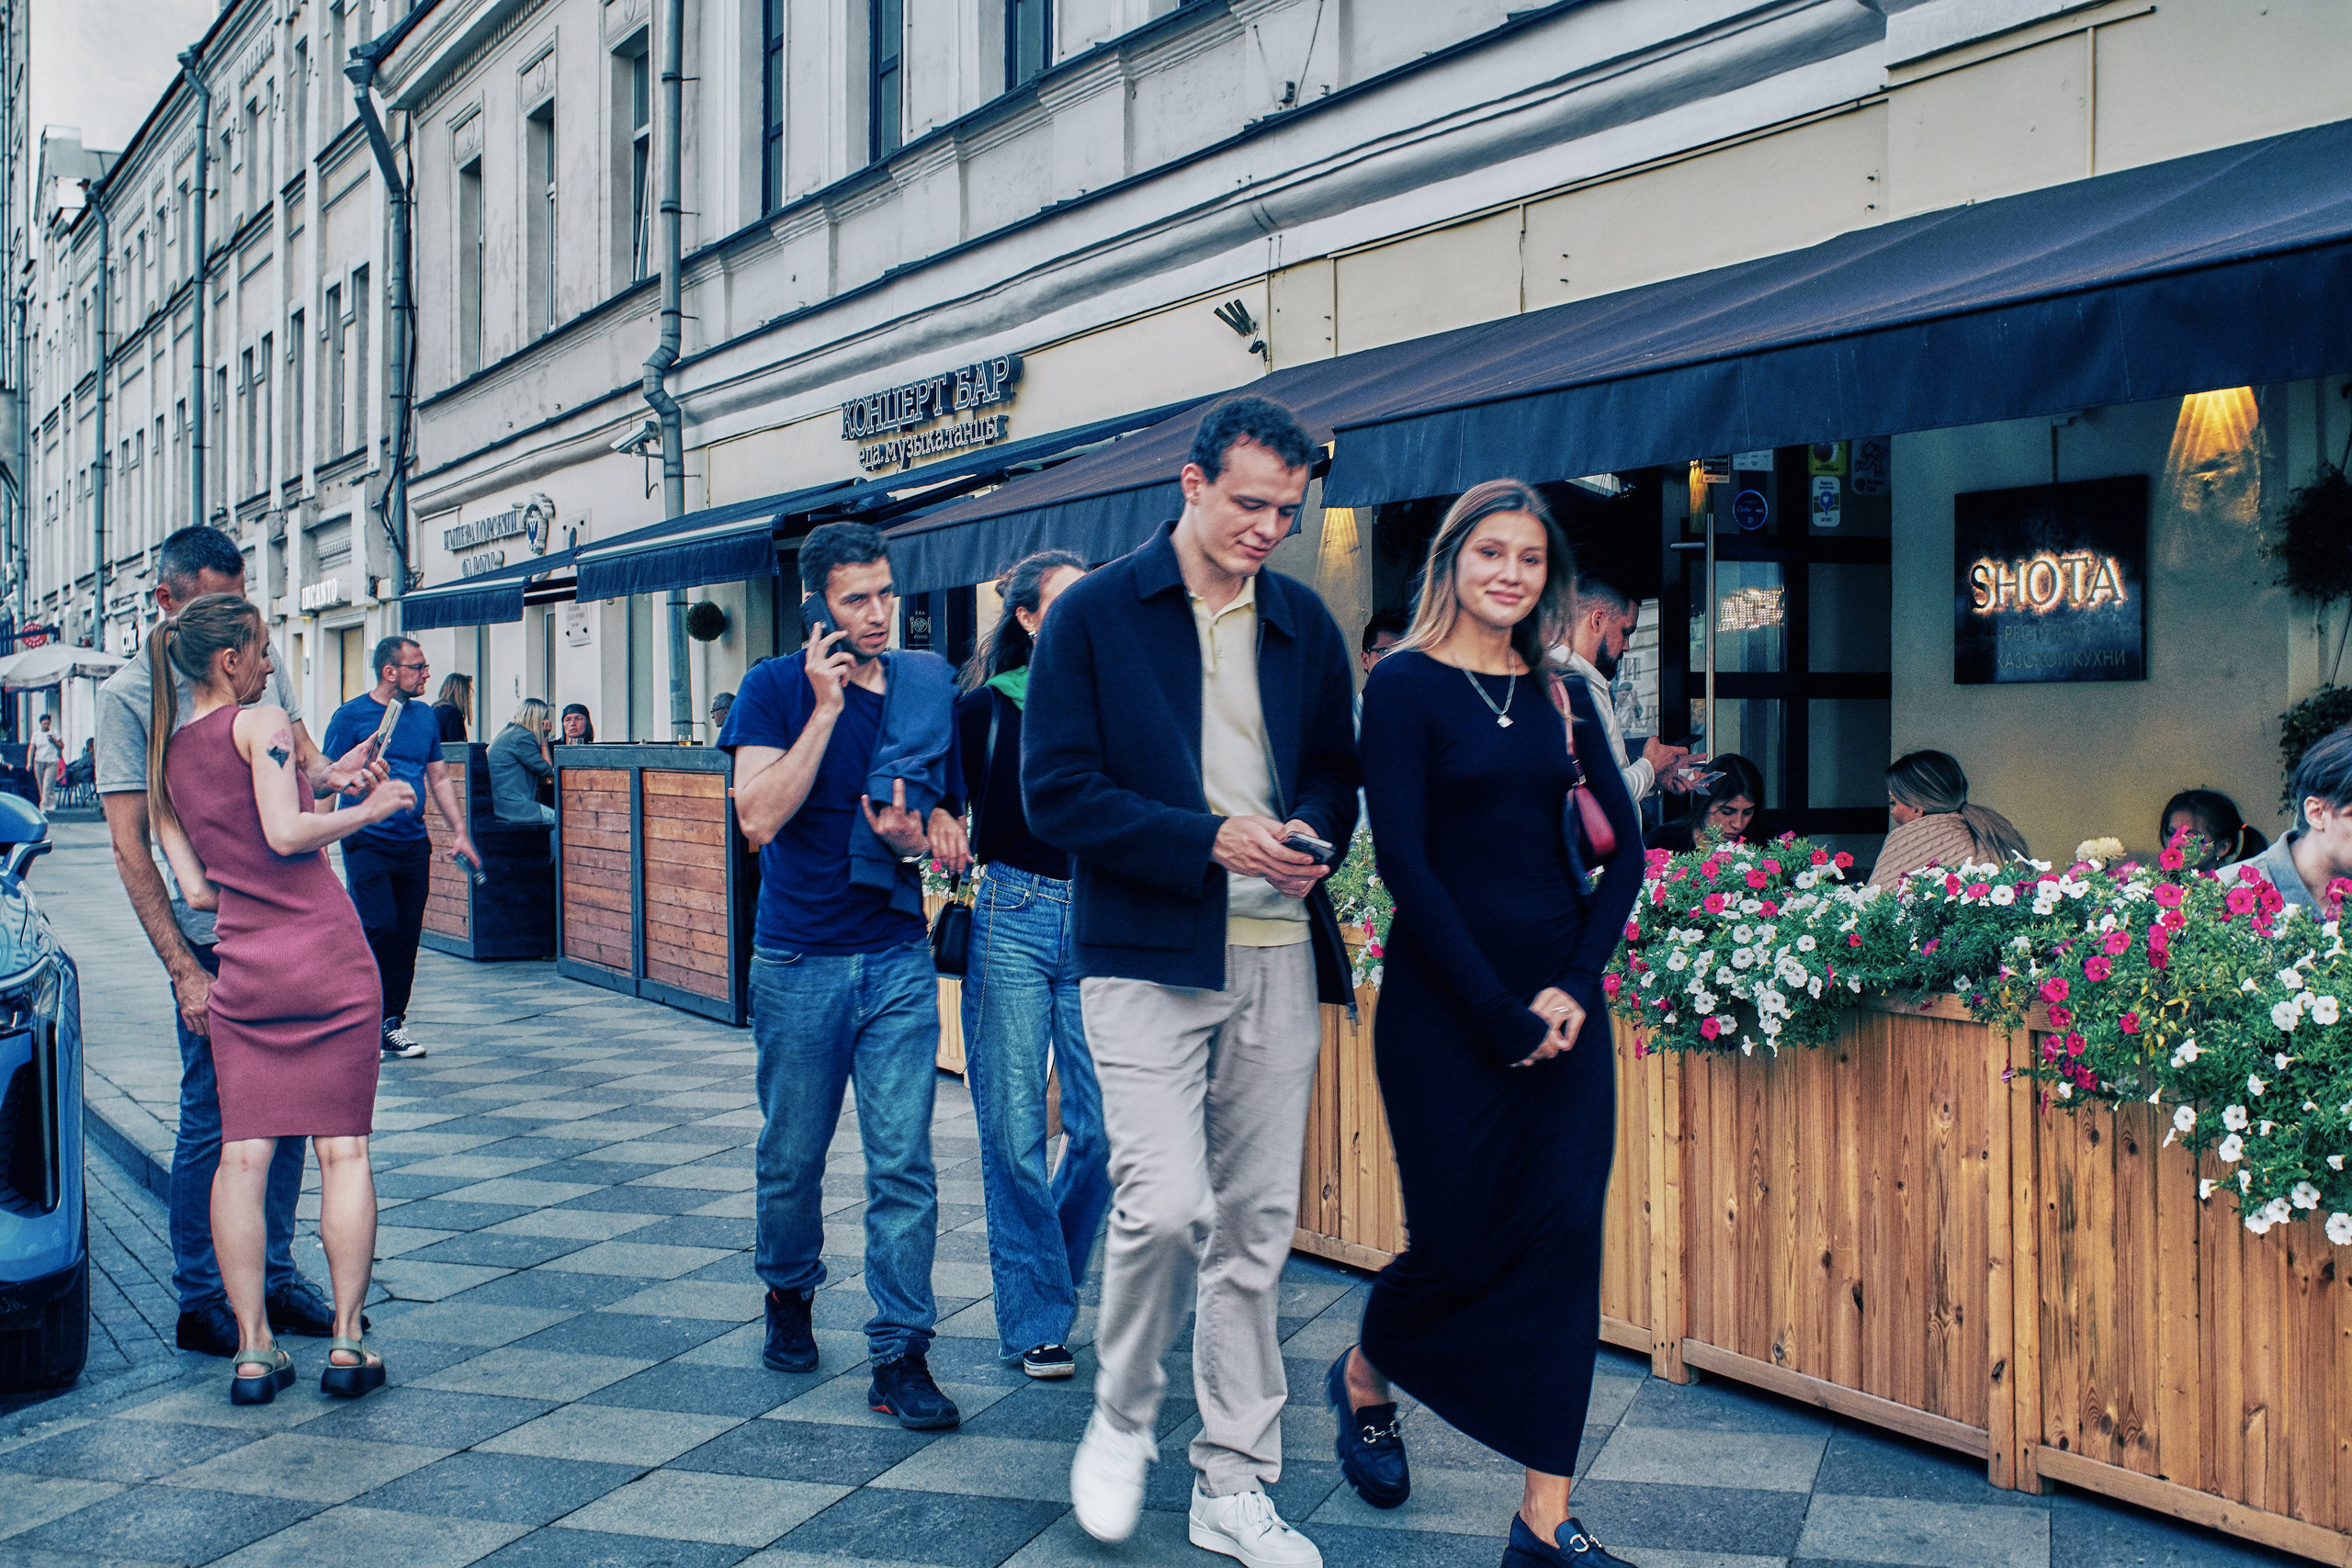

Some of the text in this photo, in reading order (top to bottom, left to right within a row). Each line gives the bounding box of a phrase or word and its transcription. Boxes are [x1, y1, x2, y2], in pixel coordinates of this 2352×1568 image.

[841, 355, 1012, 441] КОНЦЕРТ БАР
[444, 505, 520, 550] ИМПЕРАТОРСКИЙ
[301, 578, 337, 611] INCANTO
[1971, 556, 2125, 610] SHOTA
[2073, 649, 2126, 668] КУХНИ
